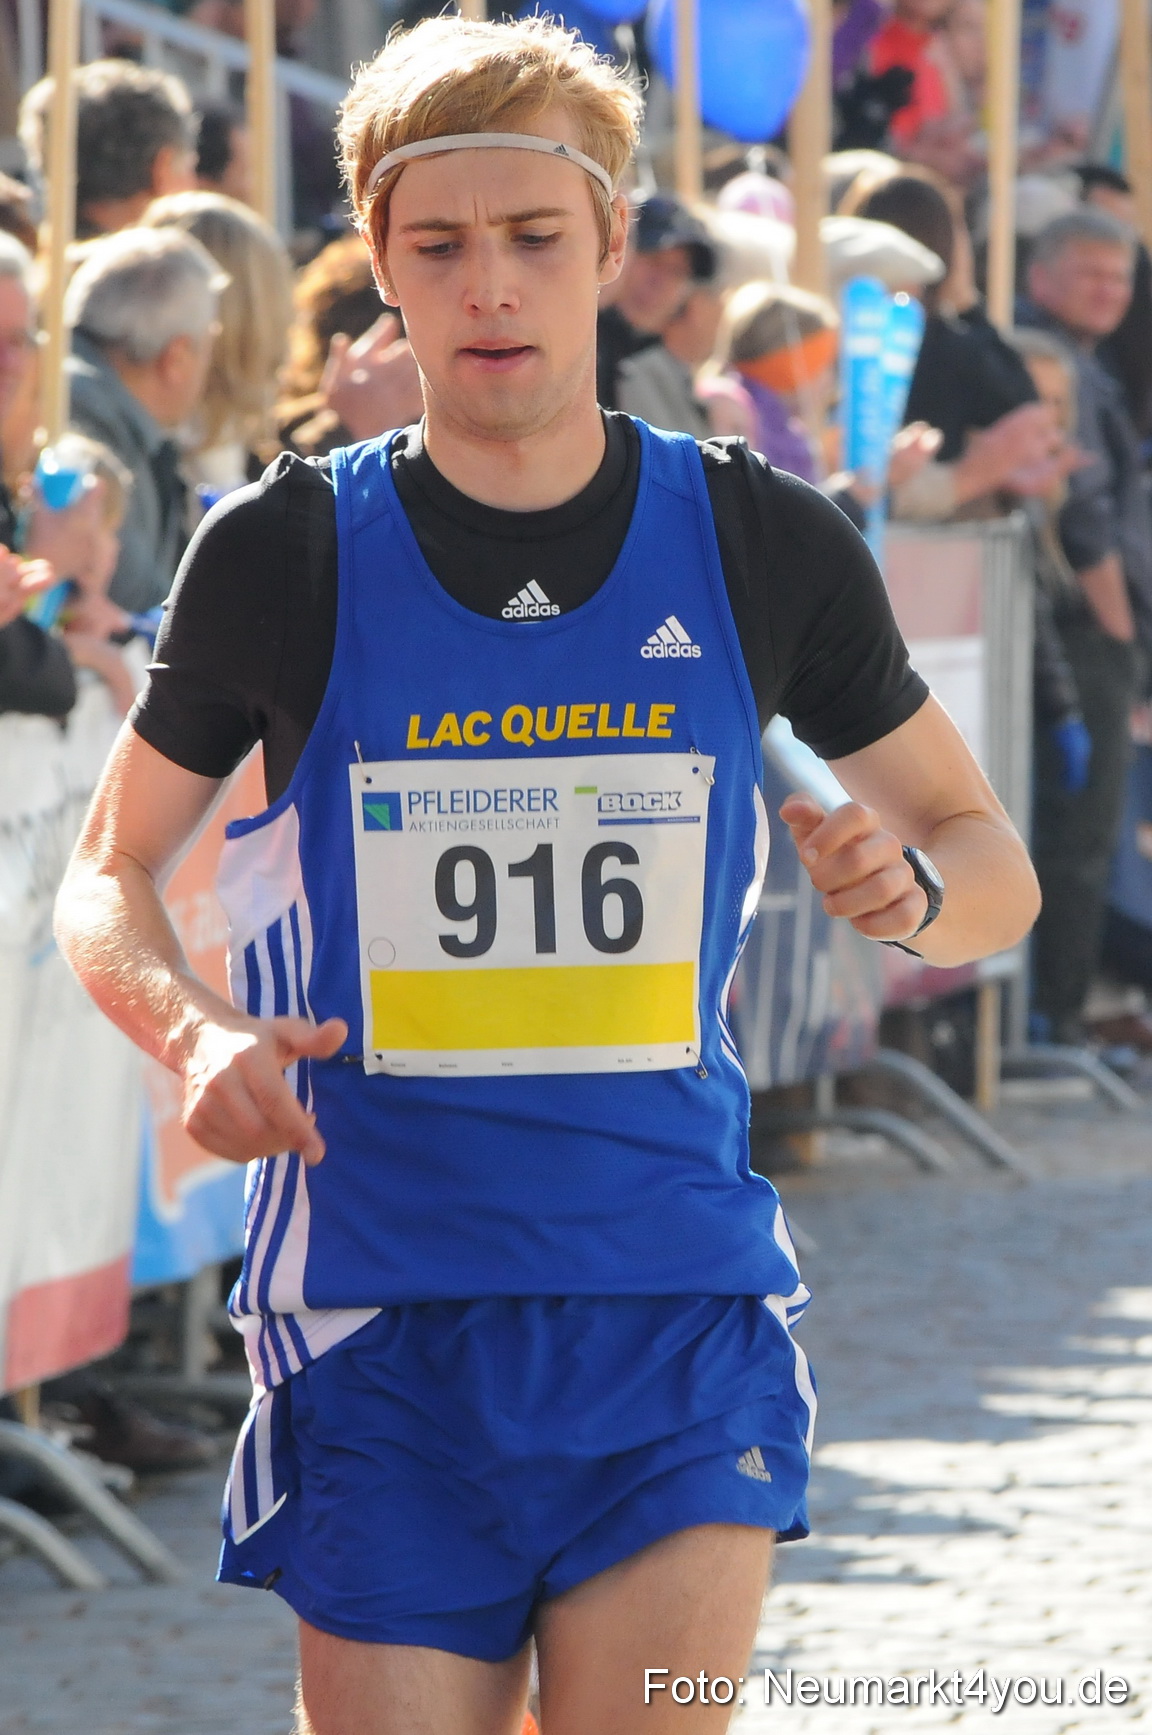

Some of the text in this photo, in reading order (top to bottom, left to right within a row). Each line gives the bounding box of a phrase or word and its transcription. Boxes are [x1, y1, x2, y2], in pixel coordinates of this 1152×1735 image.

[502, 603, 560, 618] adidas
[640, 642, 702, 659] adidas
[406, 703, 676, 749] LAC QUELLE
[407, 788, 559, 814] PFLEIDERER
[598, 791, 682, 812] BOCK
[409, 817, 560, 833] AKTIENGESELLSCHAFT
[434, 841, 644, 958] 916
